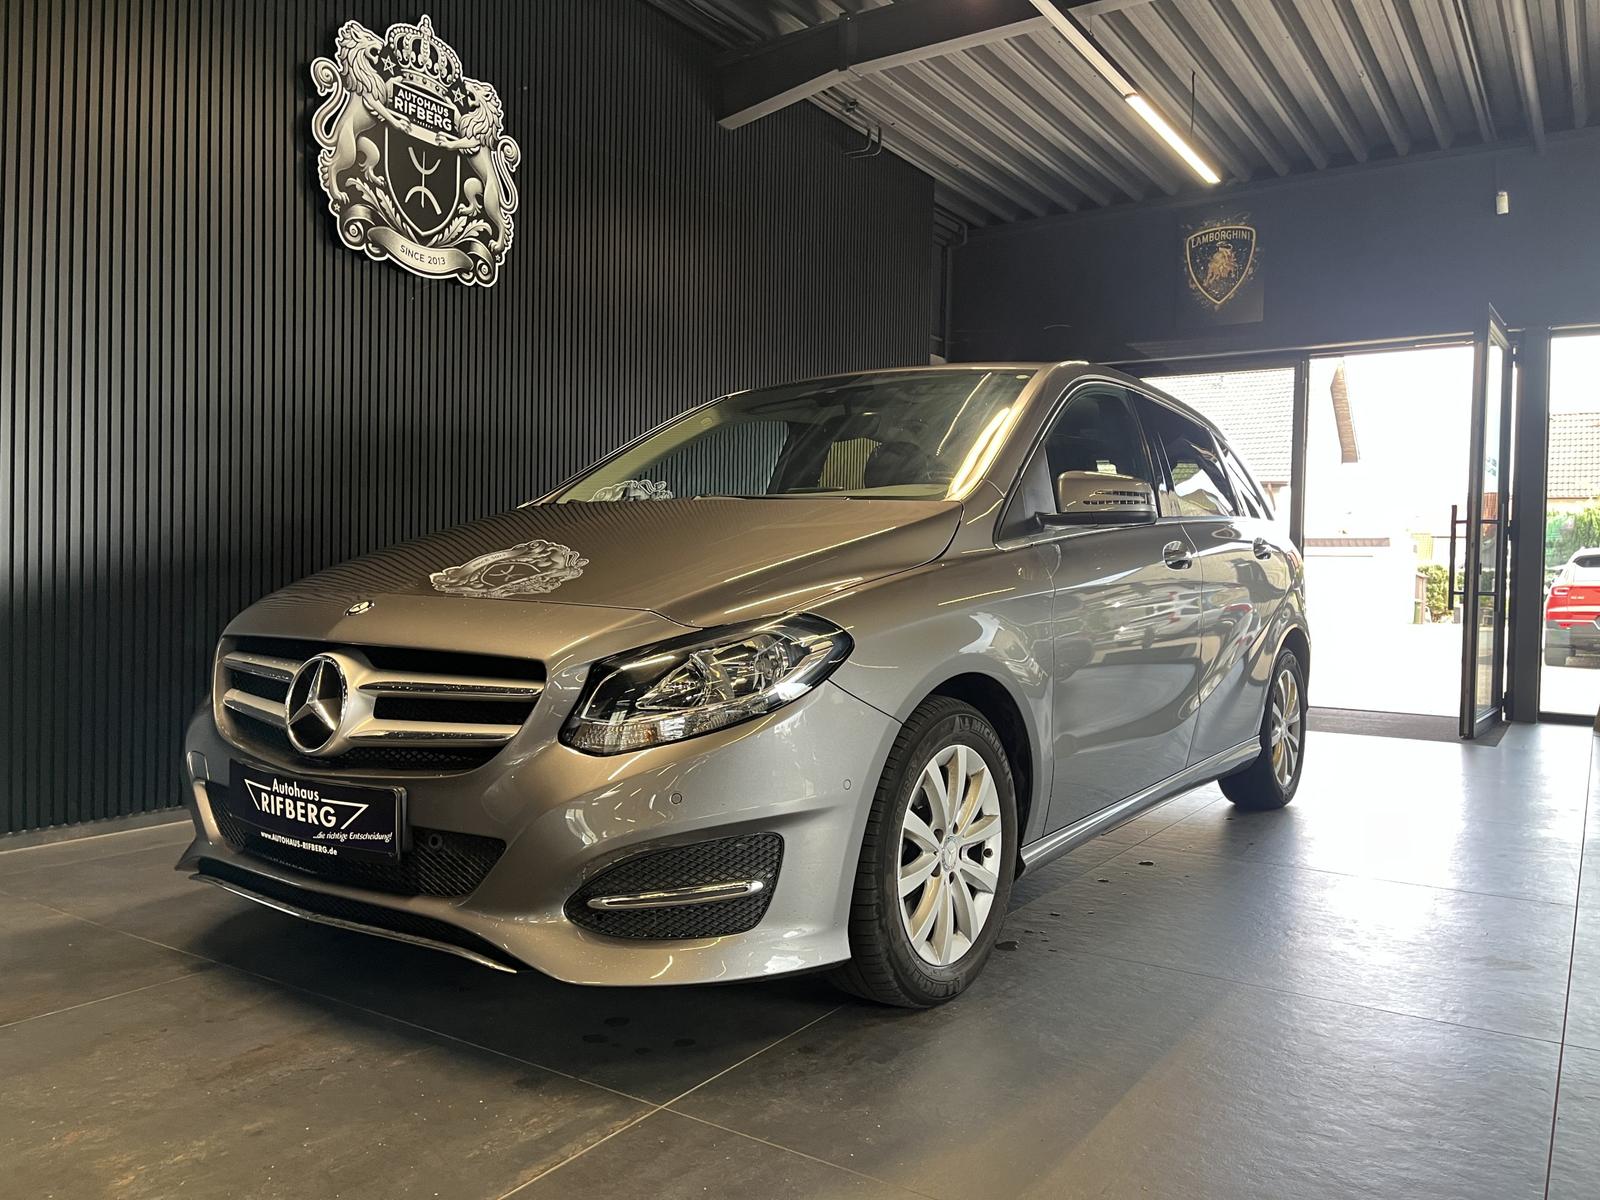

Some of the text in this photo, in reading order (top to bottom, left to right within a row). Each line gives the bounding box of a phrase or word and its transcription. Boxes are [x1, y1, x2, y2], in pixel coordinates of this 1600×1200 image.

[394, 96, 452, 131] RIFBERG
[397, 88, 449, 117] AUTOHAUS
[1191, 229, 1251, 248] LAMBORGHINI
[399, 244, 446, 265] SINCE 2013
[272, 778, 320, 801] Autohaus
[260, 792, 337, 828] RIFBERG
[260, 831, 338, 856] www.AUTOHAUS-RIFBERG.de
[326, 831, 348, 842] richtige
[349, 832, 393, 843] Entscheidung!
